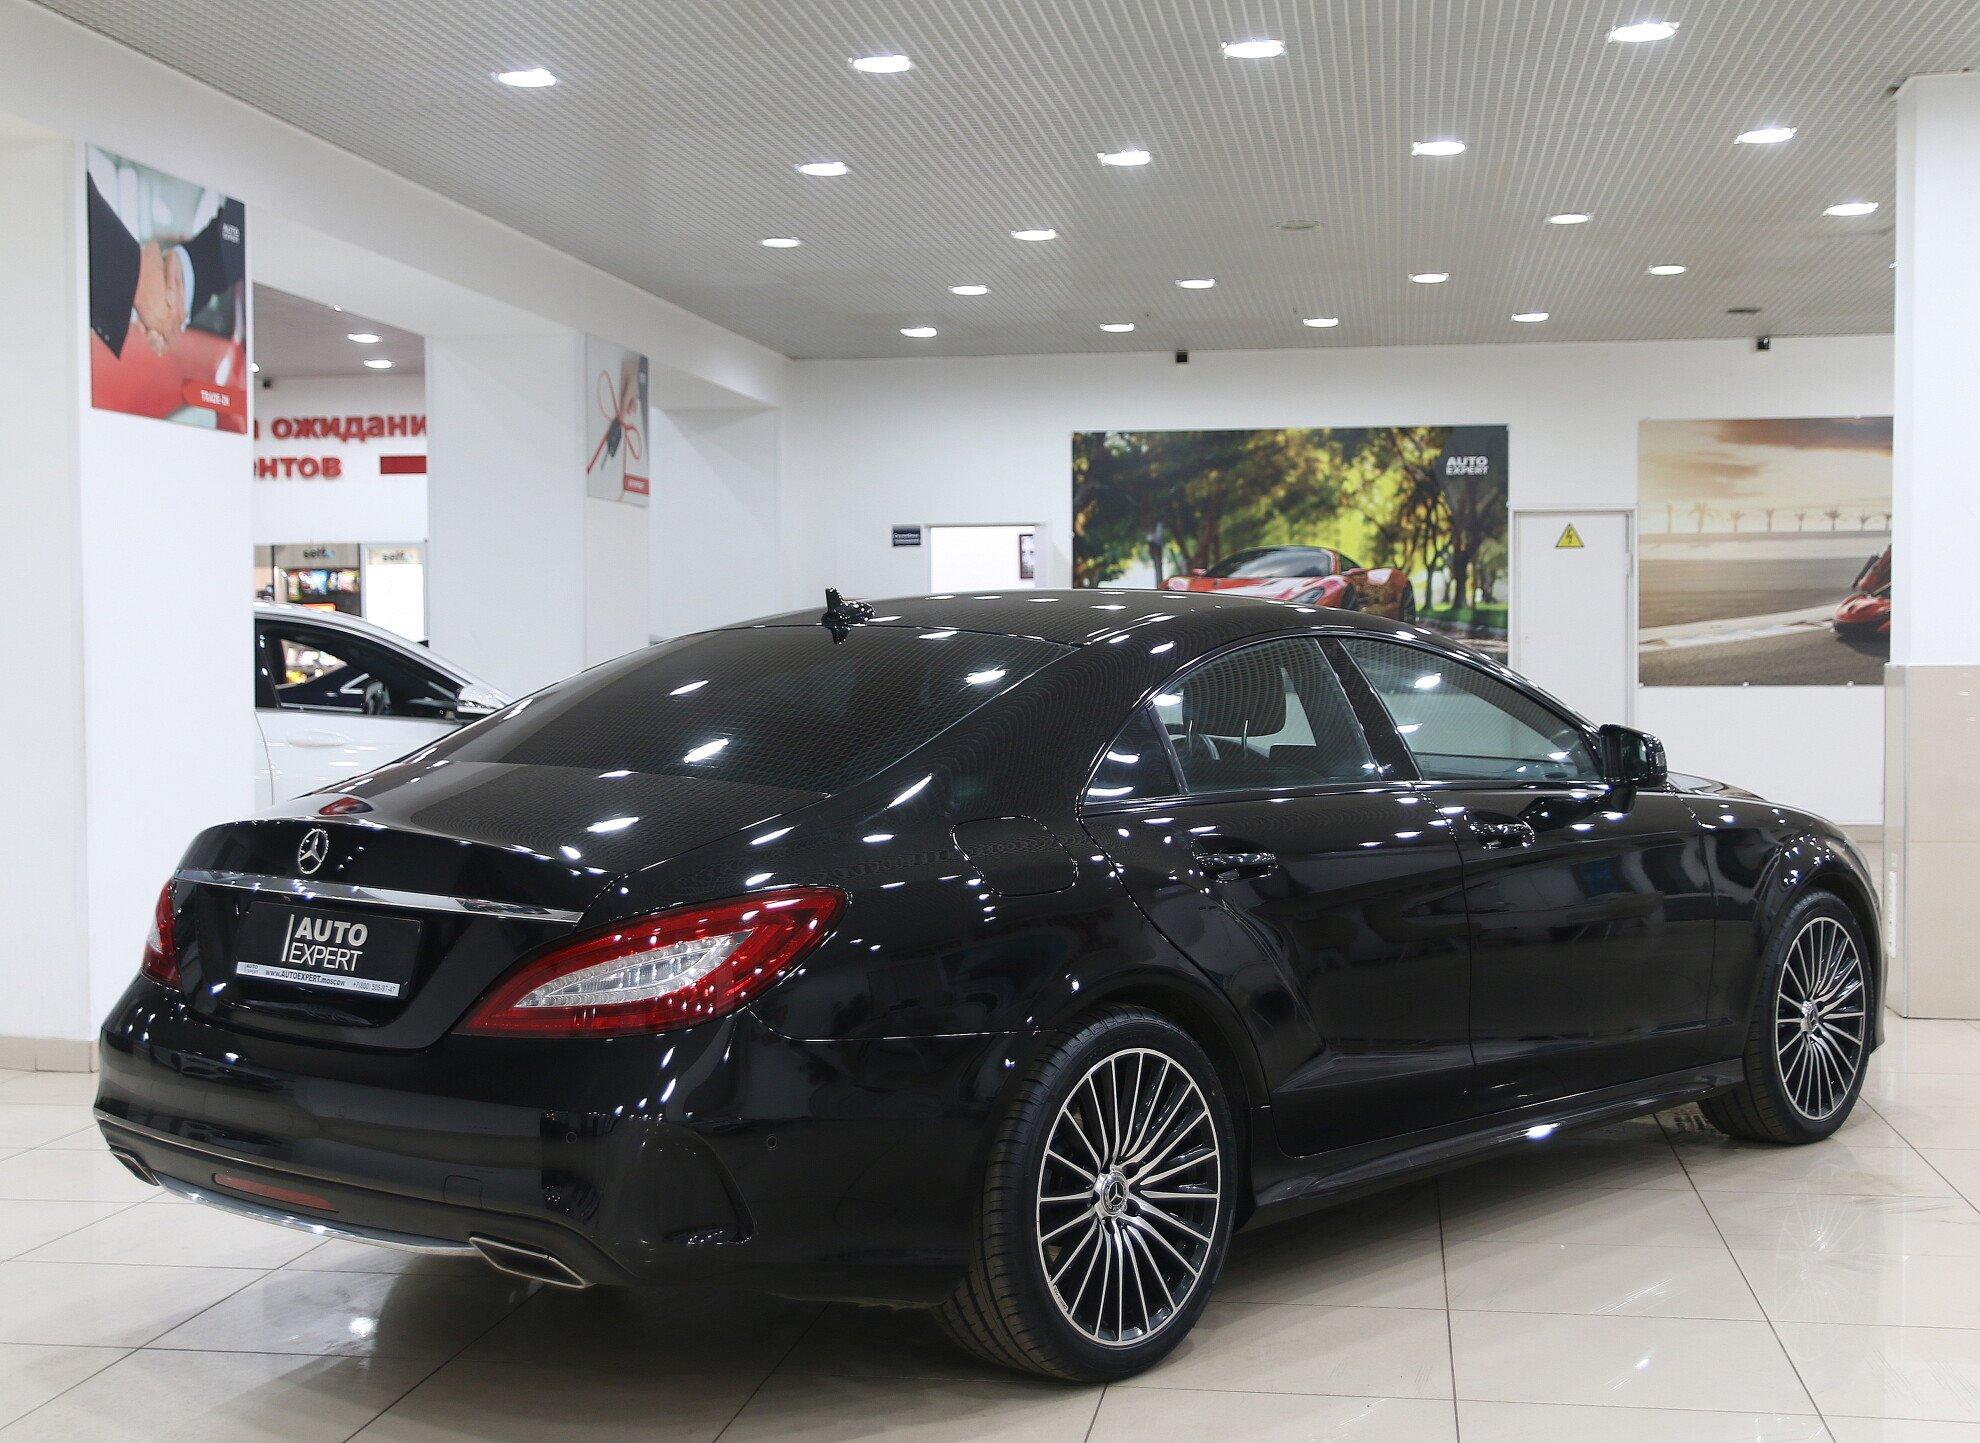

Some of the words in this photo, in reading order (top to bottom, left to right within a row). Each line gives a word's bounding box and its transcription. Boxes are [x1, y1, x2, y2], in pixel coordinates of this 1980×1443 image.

[272, 415, 427, 442] ожидани
[254, 457, 342, 478] нтов
[1446, 465, 1489, 476] EXPERT
[1447, 456, 1489, 467] AUTO
[295, 917, 368, 947] AUTO
[289, 942, 363, 972] EXPERT
[265, 969, 346, 986] www.AUTOEXPERT.moscow
